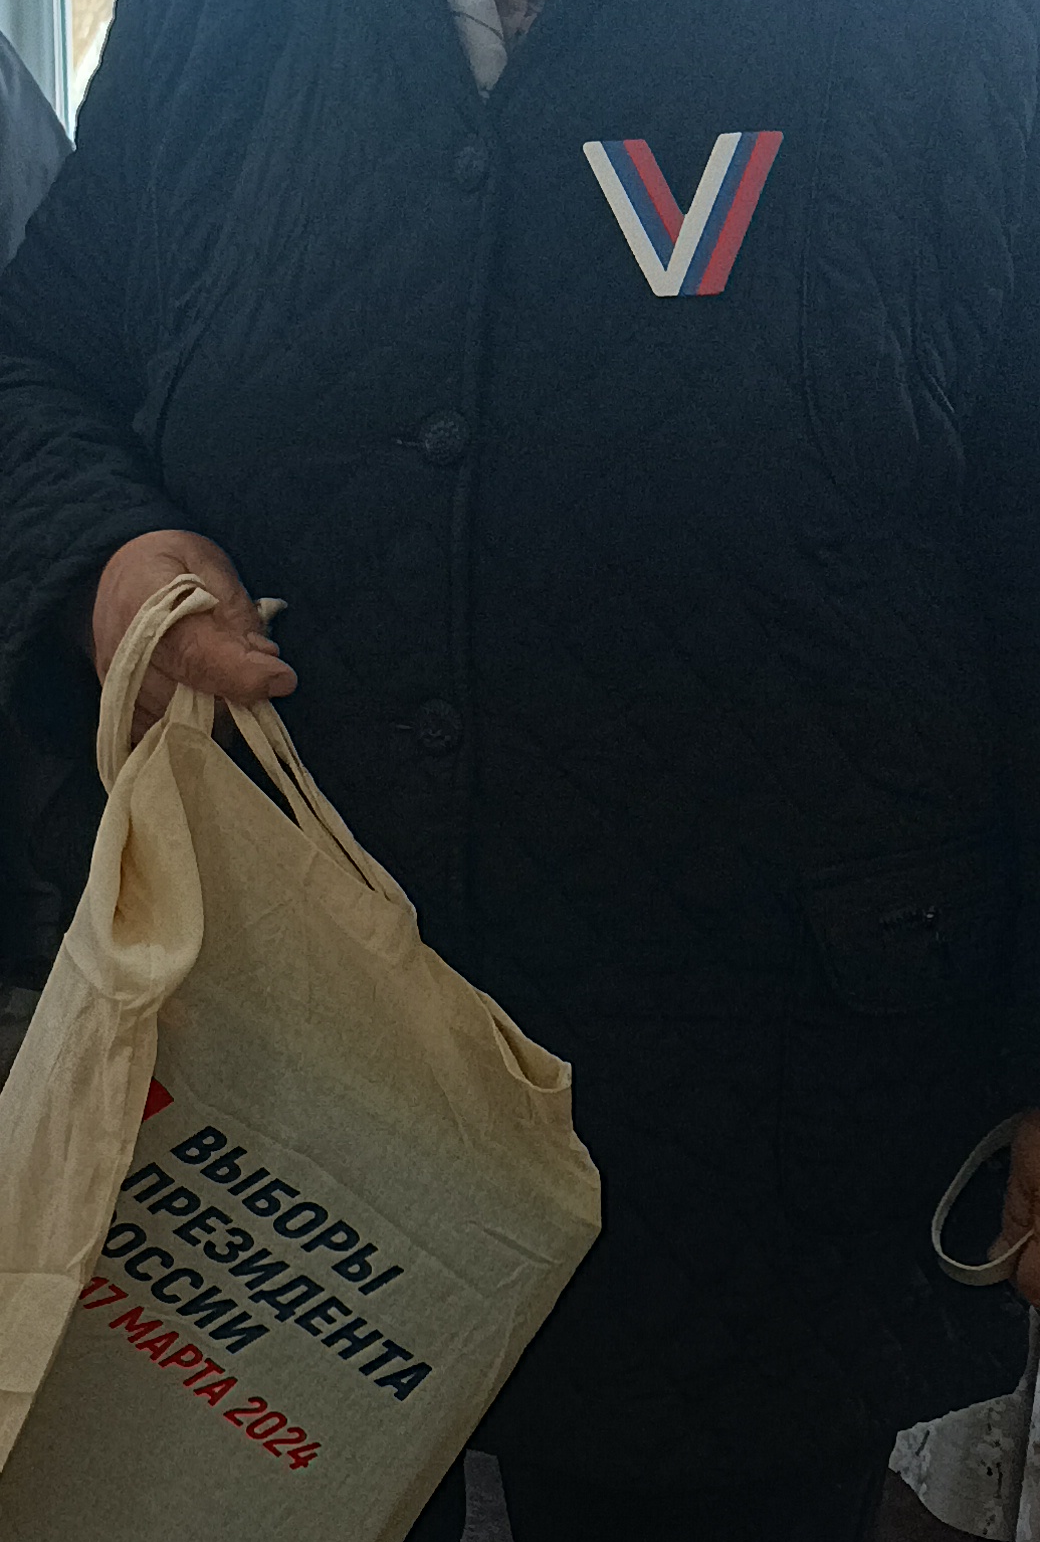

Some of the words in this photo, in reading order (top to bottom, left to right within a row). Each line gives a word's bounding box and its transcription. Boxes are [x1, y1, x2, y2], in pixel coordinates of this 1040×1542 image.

[101, 1209, 270, 1355] ОССИИ
[120, 1162, 433, 1402] ПРЕЗИДЕНТА
[170, 1125, 405, 1296] ВЫБОРЫ
[79, 1276, 129, 1310] 17
[108, 1305, 239, 1407] МАРТА
[223, 1396, 322, 1471] 2024
